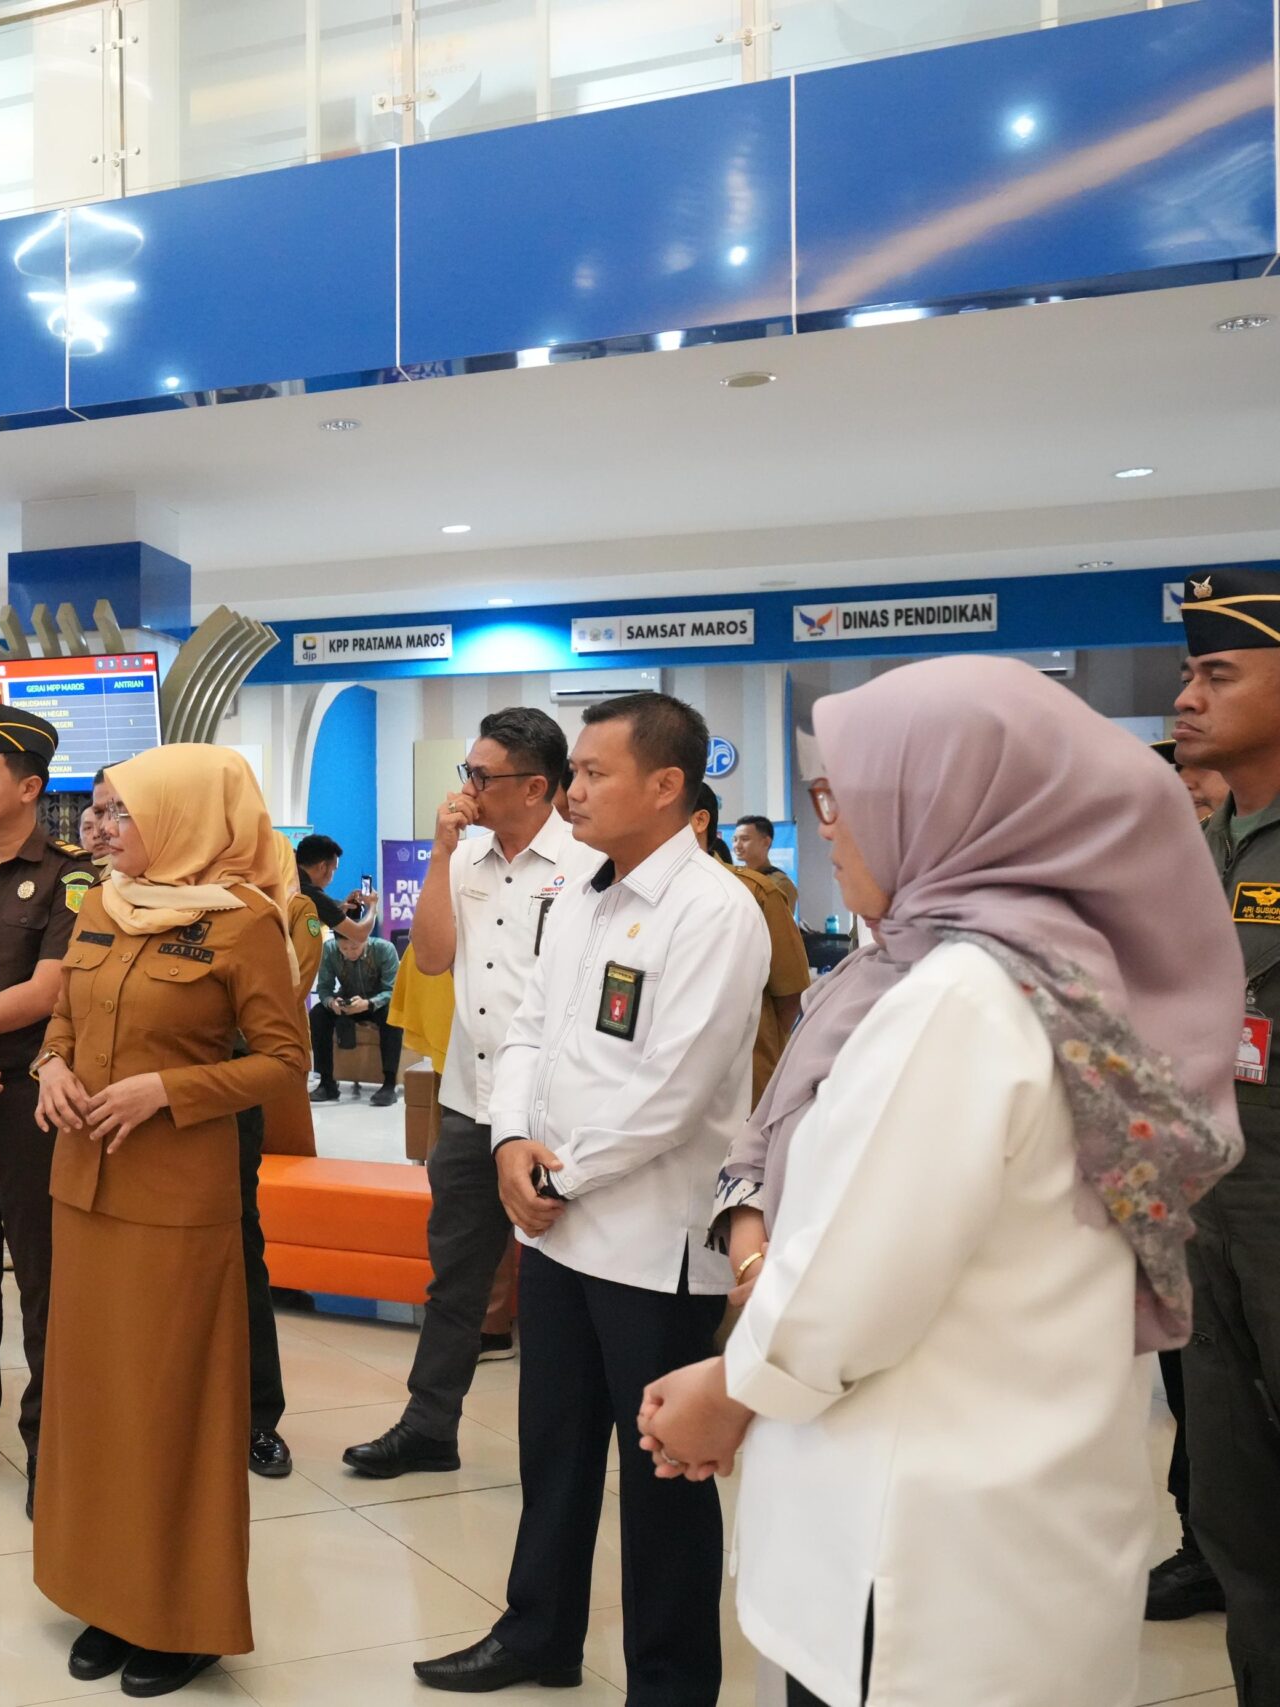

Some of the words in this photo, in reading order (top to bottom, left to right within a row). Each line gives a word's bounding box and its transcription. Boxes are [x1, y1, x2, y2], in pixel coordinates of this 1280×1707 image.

[842, 609, 890, 630] DINAS
[894, 602, 992, 627] PENDIDIKAN
[626, 623, 686, 640] SAMSAT
[690, 620, 748, 637] MAROS
[328, 638, 349, 653] KPP
[352, 635, 403, 651] PRATAMA
[405, 632, 446, 648] MAROS
[302, 651, 317, 661] djp
[114, 680, 144, 689] ANTRIAN
[396, 880, 422, 894] PIL
[390, 907, 414, 921] PA
